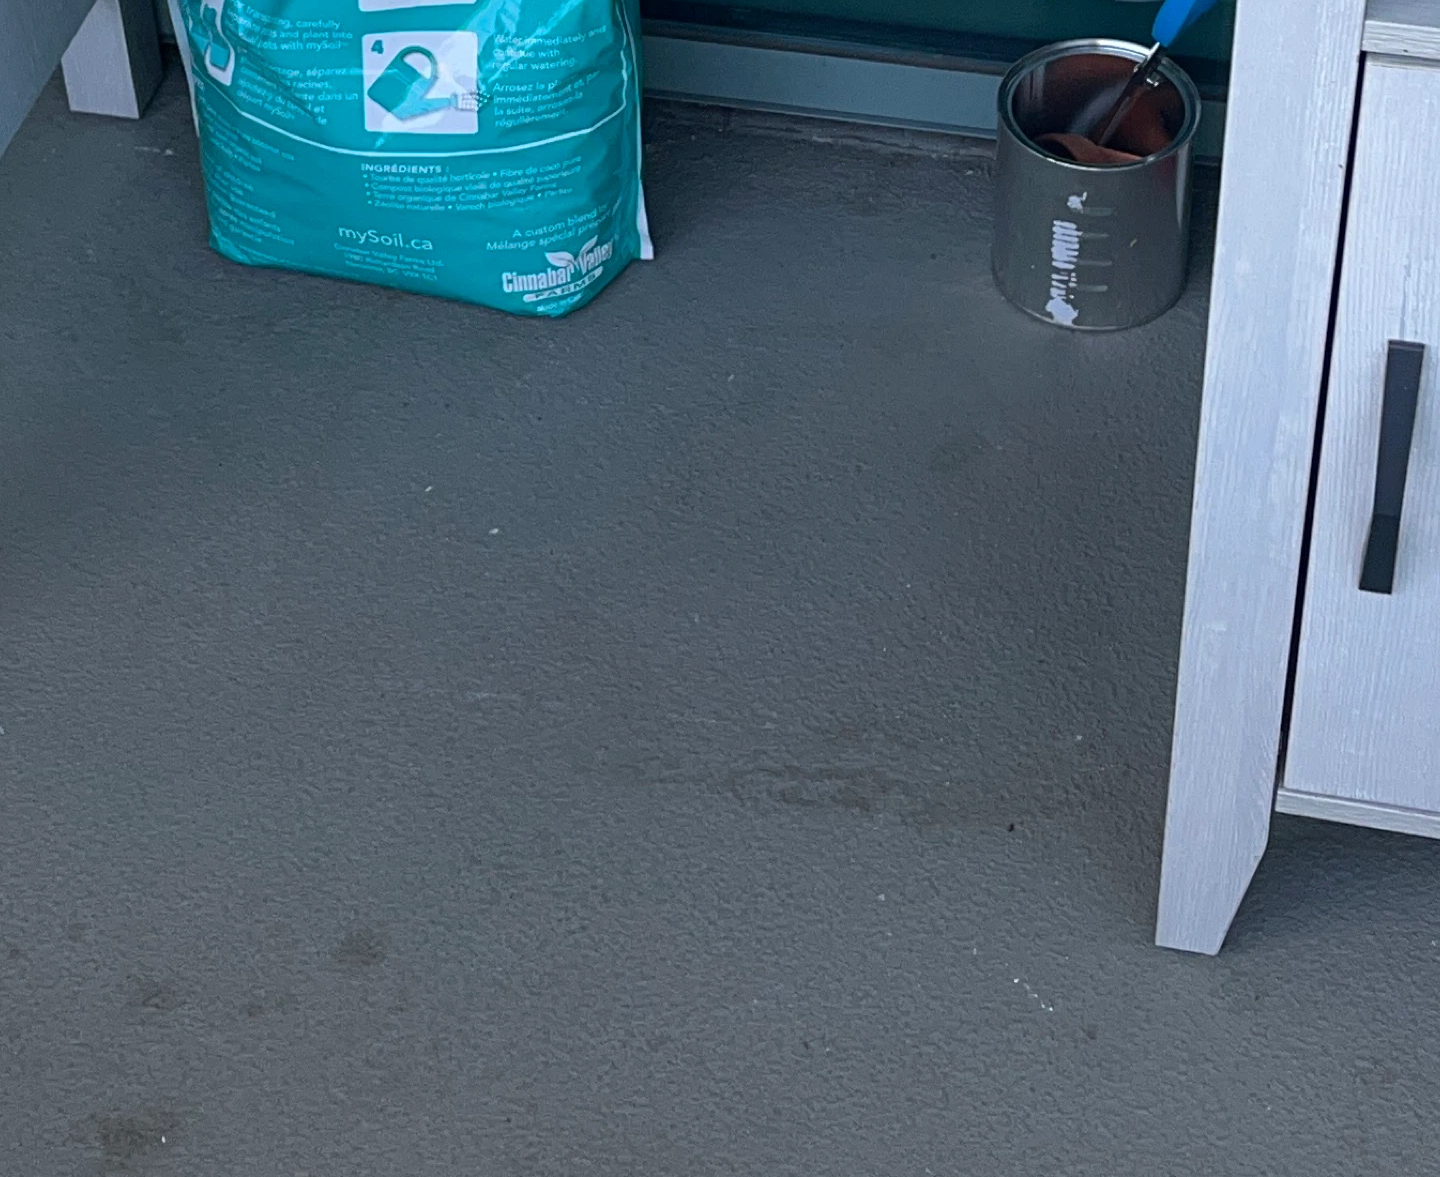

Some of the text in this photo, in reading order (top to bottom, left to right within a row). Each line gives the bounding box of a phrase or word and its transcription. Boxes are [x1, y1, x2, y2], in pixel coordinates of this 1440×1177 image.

[296, 19, 341, 30] carefully
[280, 40, 305, 50] with
[371, 40, 384, 55] 4
[538, 48, 561, 58] with
[492, 81, 533, 92] Arrosez
[360, 161, 442, 174] INGRÉDIENTS
[512, 228, 523, 239] A
[524, 221, 566, 238] custom
[567, 207, 598, 226] blend
[338, 226, 434, 251] mySoil.ca
[486, 238, 537, 251] Mélange
[538, 230, 577, 247] spécial
[501, 262, 576, 294] Cinnabar
